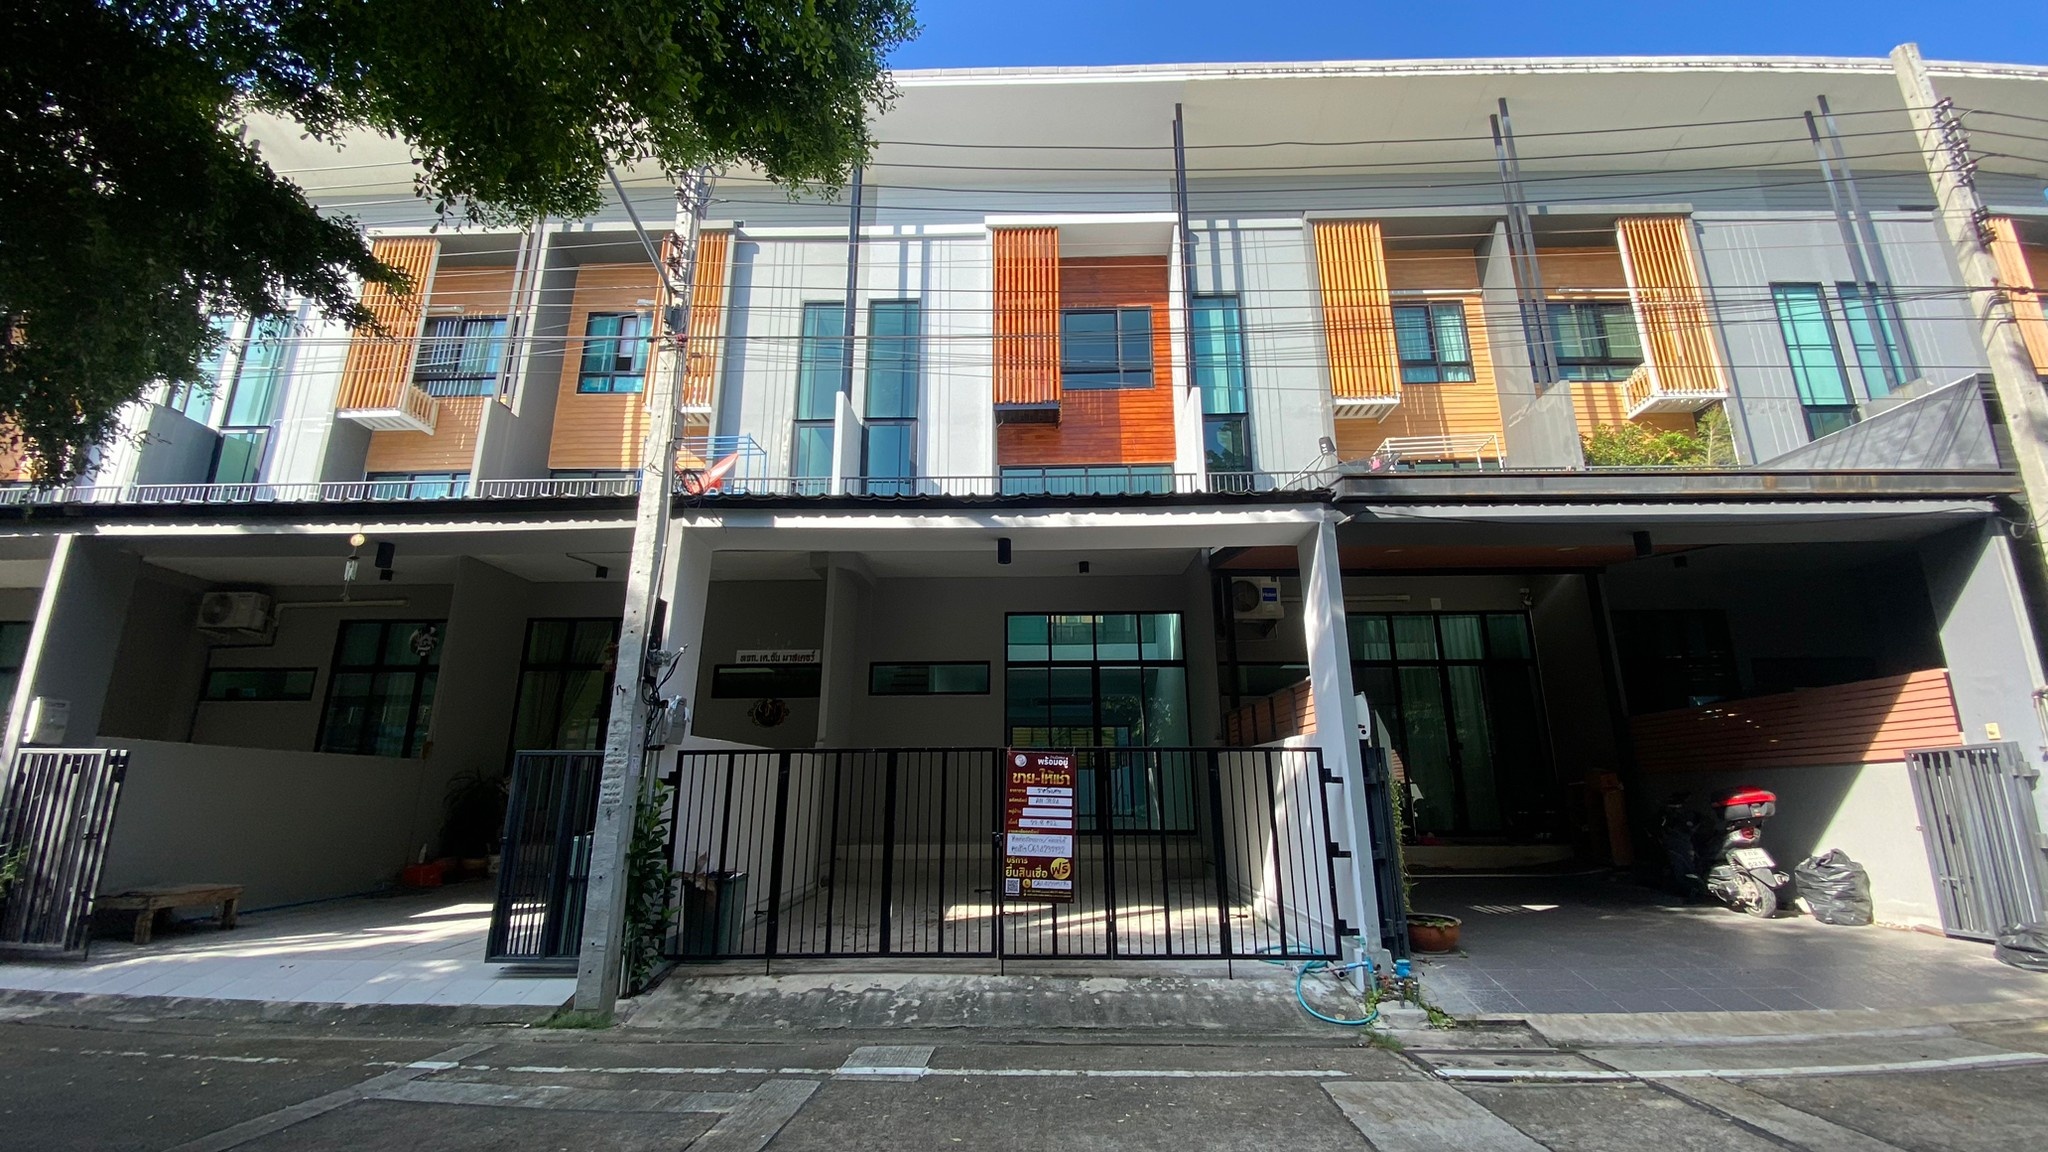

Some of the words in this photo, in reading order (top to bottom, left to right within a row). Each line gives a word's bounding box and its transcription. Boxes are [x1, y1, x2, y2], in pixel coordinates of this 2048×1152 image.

[1006, 856, 1028, 864] บริการ
[1005, 864, 1048, 878] ยื่นสินเชื่อ
[1052, 860, 1069, 875] ฟรี
